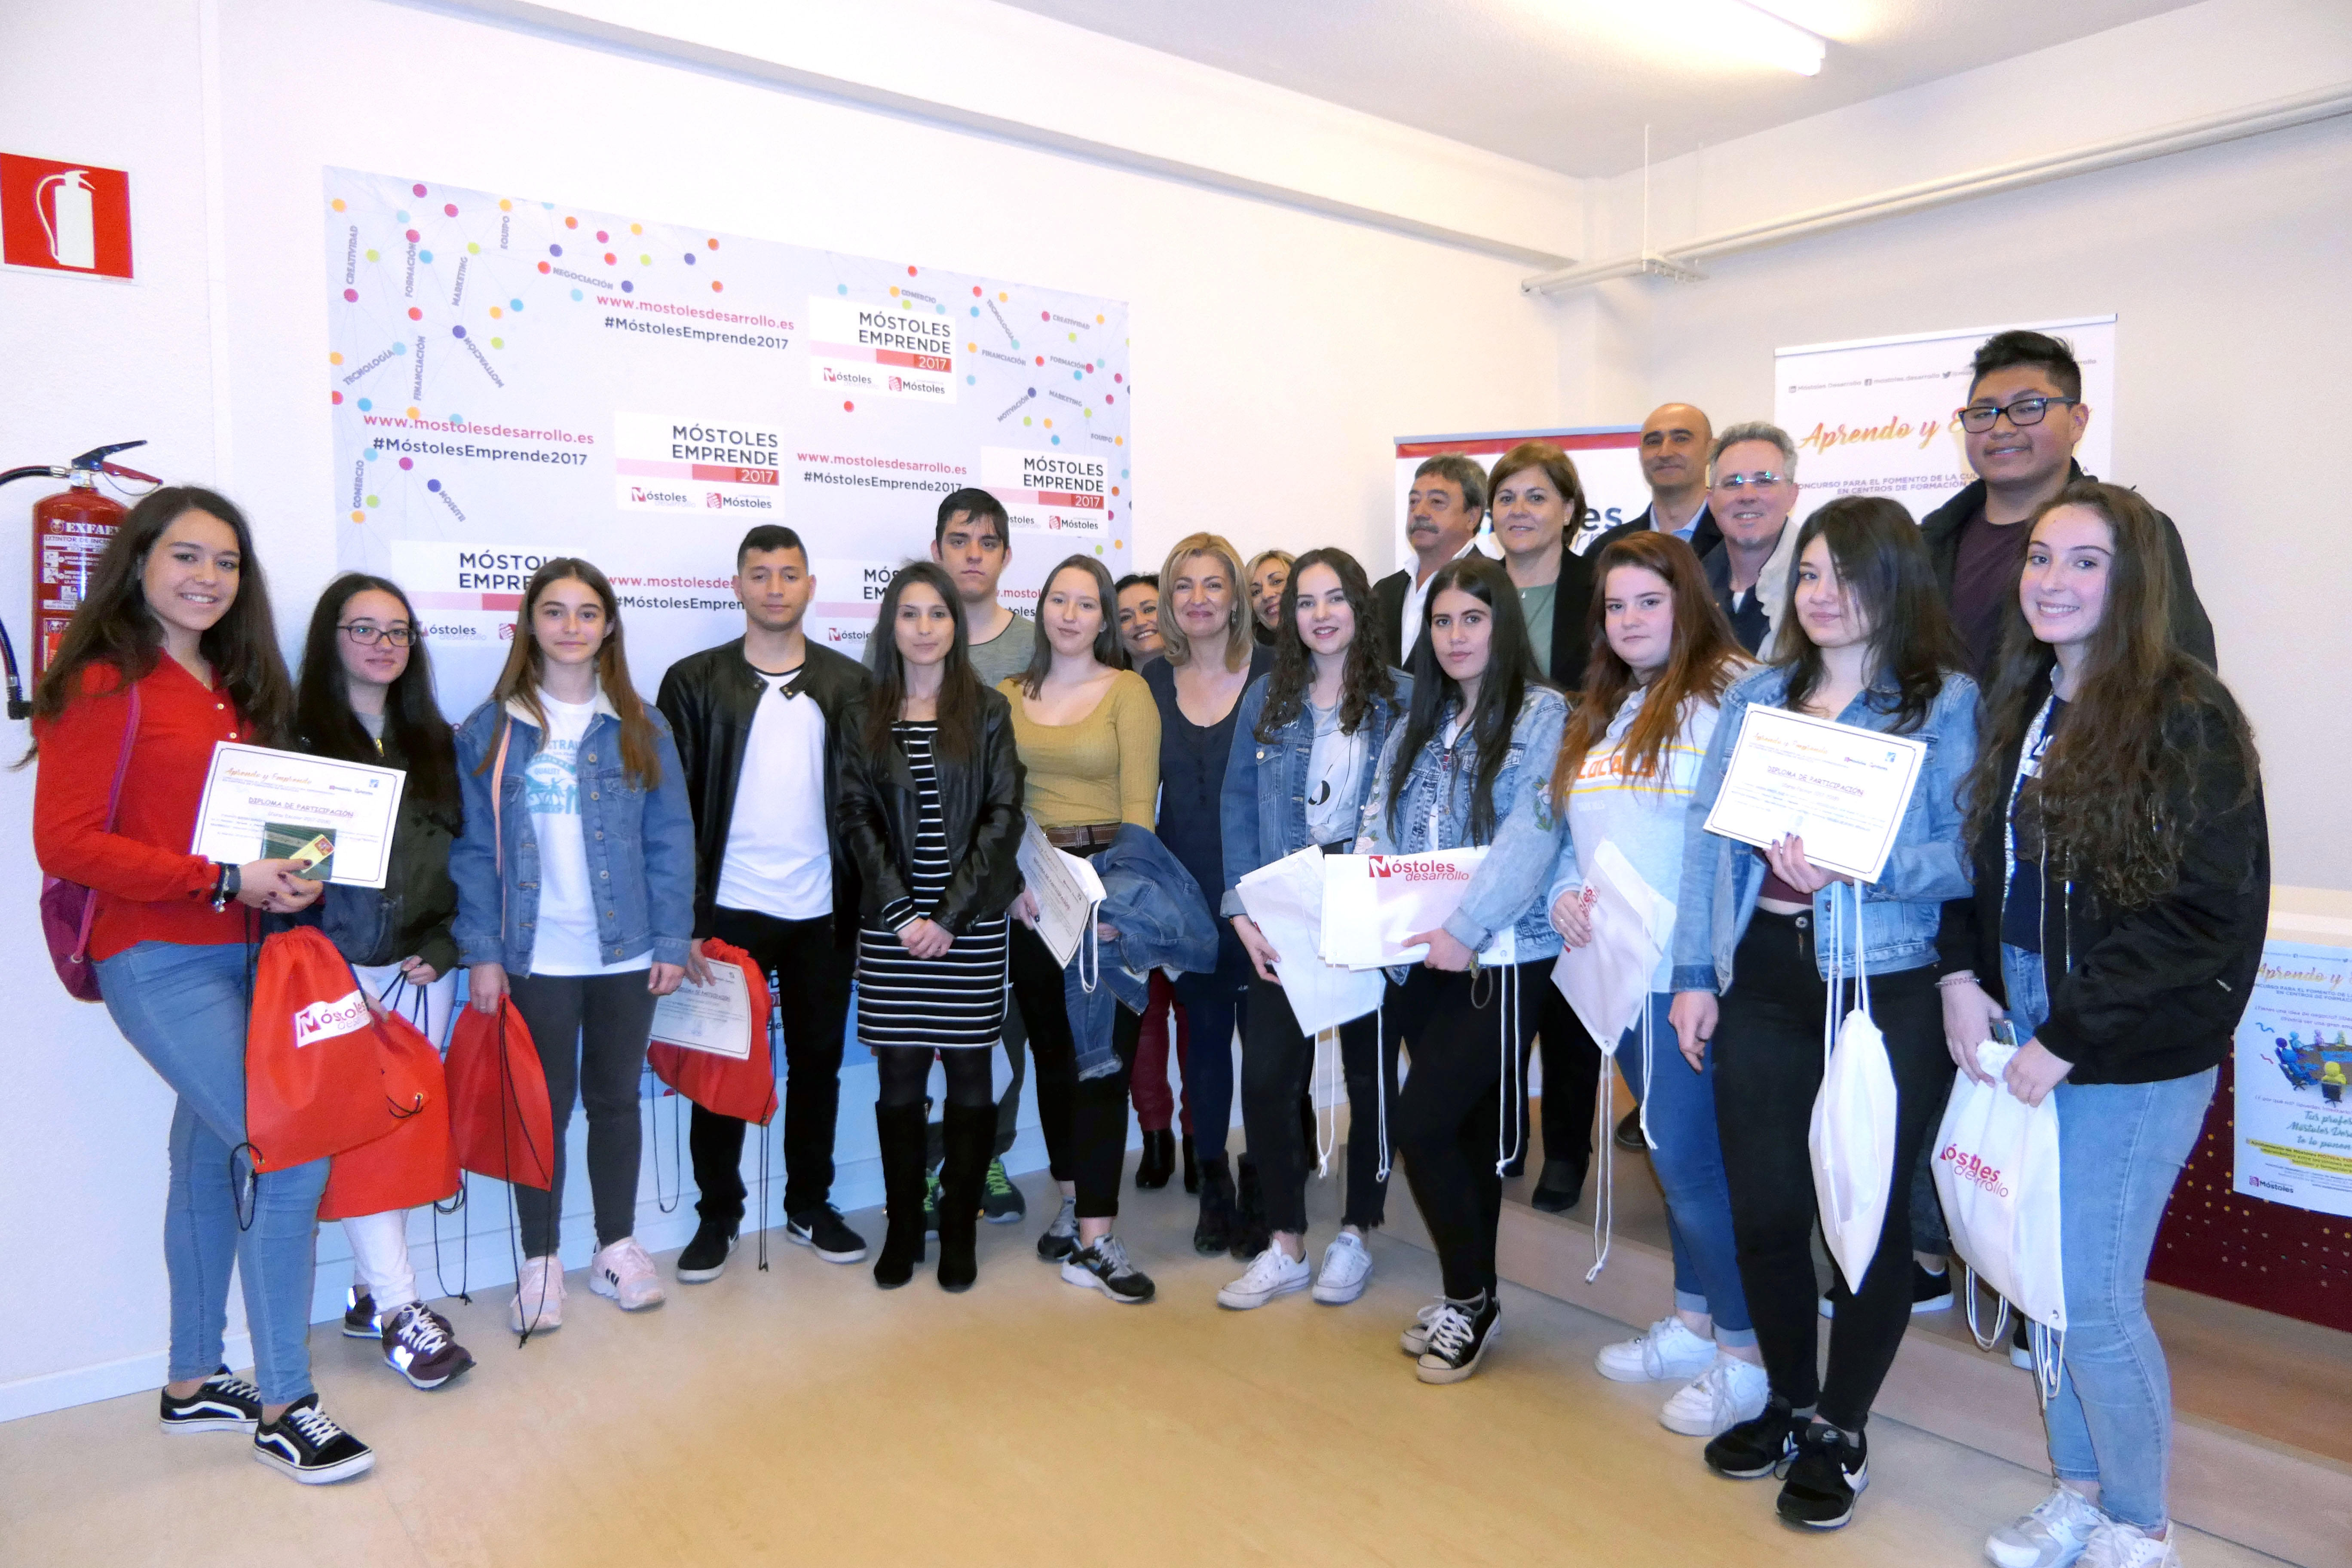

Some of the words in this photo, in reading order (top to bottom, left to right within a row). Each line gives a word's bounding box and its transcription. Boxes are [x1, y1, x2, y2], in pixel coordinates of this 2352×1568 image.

[500, 216, 510, 249] EQUIPO
[346, 225, 358, 285] CREATIVIDAD
[405, 242, 416, 298] FORMACIÓN
[452, 256, 468, 306] MARKETING
[553, 267, 613, 290] NEGOCIACIÓN
[901, 289, 937, 303] COMERCIO
[597, 295, 794, 330] www.mostolesdesarrollo.es
[987, 298, 1014, 340] TECNOLOGÍA
[1052, 314, 1090, 330] CREATIVIDAD
[604, 316, 789, 350] #MóstolesEmprende2017
[860, 310, 951, 338] MÓSTOLES
[859, 329, 951, 355] EMPRENDE
[343, 349, 395, 386] TECNOLOGÍA
[413, 335, 426, 401] FINANCIACIÓN
[463, 337, 505, 389] MOTIVACIÓN
[918, 356, 948, 371] 2017
[982, 349, 1026, 366] FINANCIACIÓN
[1050, 355, 1086, 371] FORMACIÓN
[903, 380, 945, 395] Móstoles
[1049, 389, 1083, 407] MARKETING
[997, 394, 1030, 423] MOTIVACIÓN
[364, 414, 594, 445] www.mostolesdesarrollo.es
[672, 423, 779, 448] MÓSTOLES
[1091, 433, 1113, 444] EQUIPO
[1798, 415, 1915, 455] Aprendo
[1918, 420, 1941, 450] y
[373, 437, 588, 466] #MóstolesEmprende2017
[672, 444, 779, 467] EMPRENDE
[797, 451, 968, 475] www.mostolesdesarrollo.es
[1024, 456, 1104, 477] MÓSTOLES
[353, 459, 364, 509] COMERCIO
[741, 469, 775, 484] 2017
[804, 471, 963, 493] #MóstolesEmprende2017
[1023, 474, 1104, 493] EMPRENDE
[1795, 481, 1841, 490] ONCURSO
[1843, 478, 1867, 487] PARA
[1869, 478, 1880, 486] EL
[1882, 475, 1928, 484] FOMENTO
[1851, 484, 1892, 494] CENTROS
[1910, 480, 1966, 490] FORMACIÓN
[439, 490, 467, 522] ILUSIÓN
[723, 496, 772, 509] Móstoles
[1075, 495, 1101, 508] 2017
[1010, 516, 1035, 525] stoles
[1061, 519, 1099, 530] Móstoles
[460, 549, 548, 571] MÓSTO
[459, 573, 533, 590] EMPRE
[1767, 765, 1797, 779] DIPLOMA
[1798, 773, 1807, 781] DE
[1809, 775, 1865, 796] PARTICIPACIÓN
[248, 796, 282, 808] DIPLOMA
[284, 802, 294, 810] DE
[296, 803, 354, 818] PARTICIPACIÓN
[1369, 855, 1455, 878] Móstoles
[1405, 870, 1469, 882] desarrollo
[2304, 1110, 2320, 1121] Tus
[2297, 1135, 2306, 1144] te
[2309, 1136, 2318, 1145] lo
[2319, 1140, 2352, 1150] ponen
[2260, 1180, 2294, 1194] Móstoles
